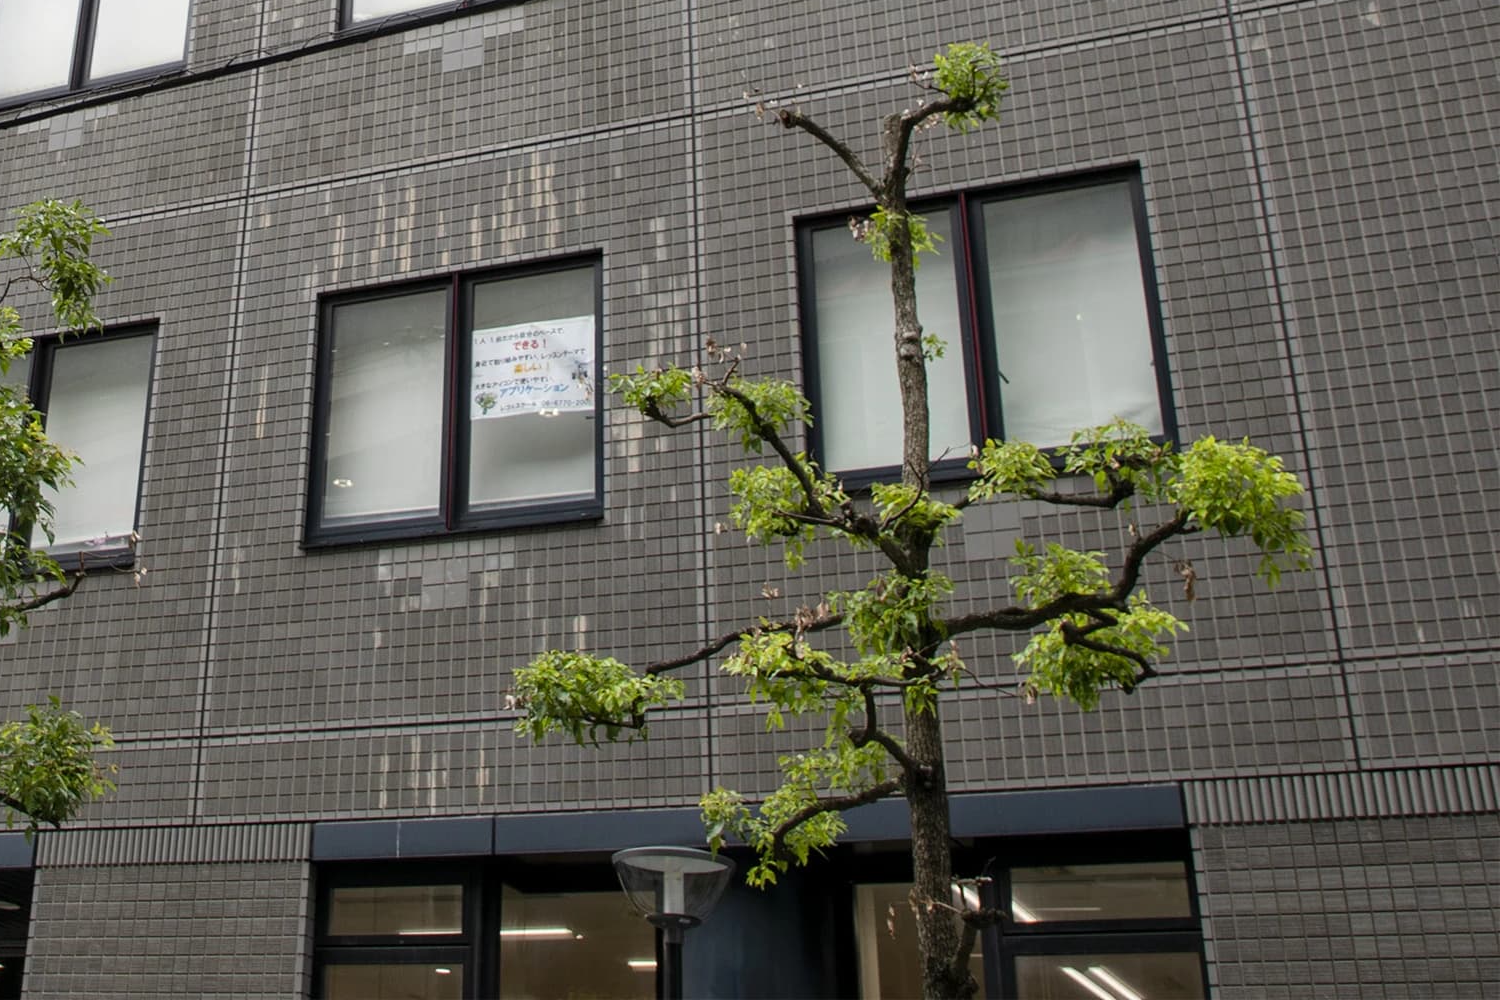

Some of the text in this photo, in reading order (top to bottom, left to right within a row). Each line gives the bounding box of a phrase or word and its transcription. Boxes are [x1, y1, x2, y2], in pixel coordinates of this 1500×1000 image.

[500, 384, 570, 398] アプリケーション
